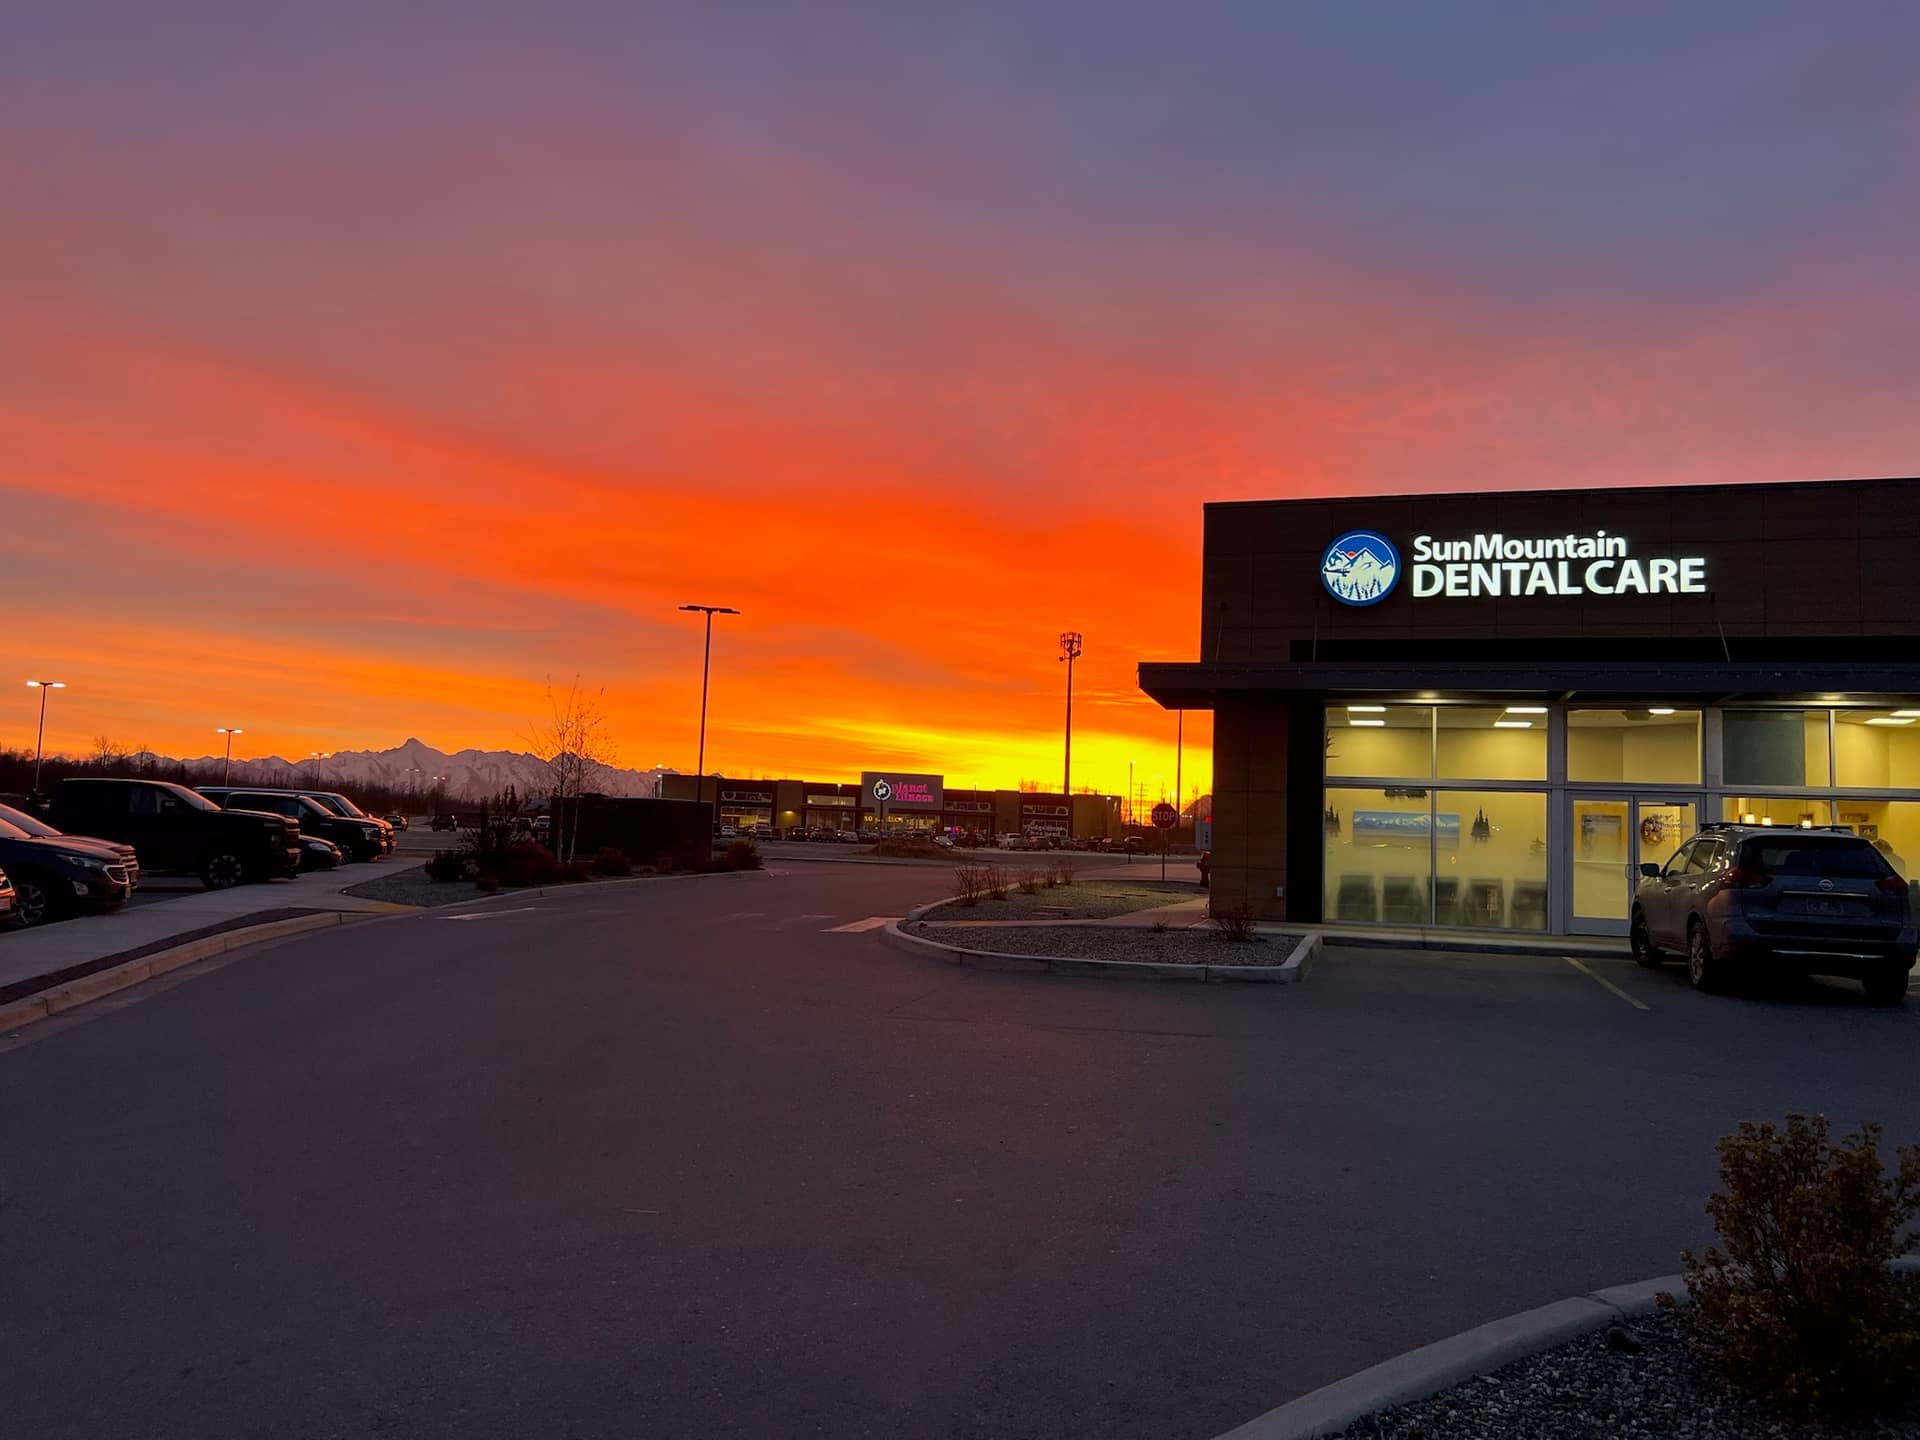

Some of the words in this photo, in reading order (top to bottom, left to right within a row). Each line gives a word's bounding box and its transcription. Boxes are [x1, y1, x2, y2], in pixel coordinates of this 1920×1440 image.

[1413, 530, 1627, 562] SunMountain
[1413, 562, 1583, 597] DENTAL
[1585, 558, 1706, 595] CARE
[1152, 810, 1175, 822] STOP
